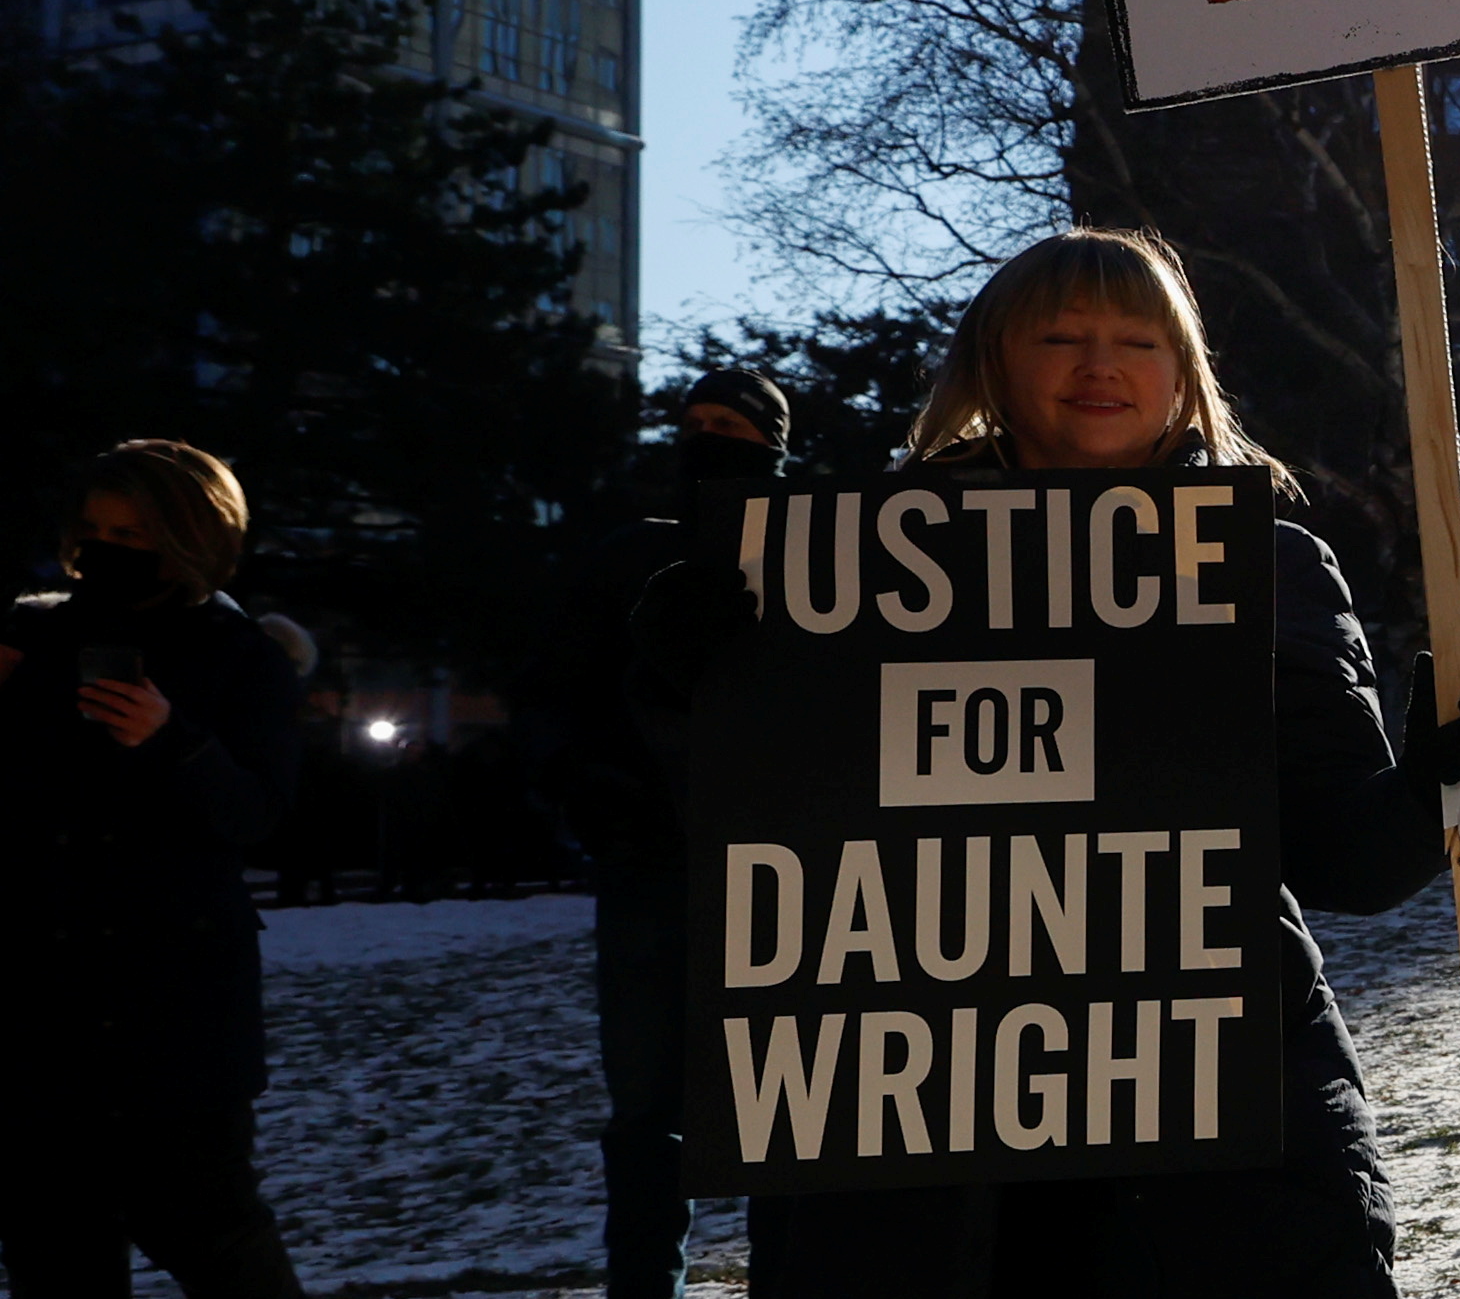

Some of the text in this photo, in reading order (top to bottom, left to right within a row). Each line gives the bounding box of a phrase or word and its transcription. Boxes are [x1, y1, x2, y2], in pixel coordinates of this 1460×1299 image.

[916, 687, 1066, 776] FOR
[723, 827, 1244, 989] DAUNTE
[722, 996, 1245, 1164] WRIGHT
